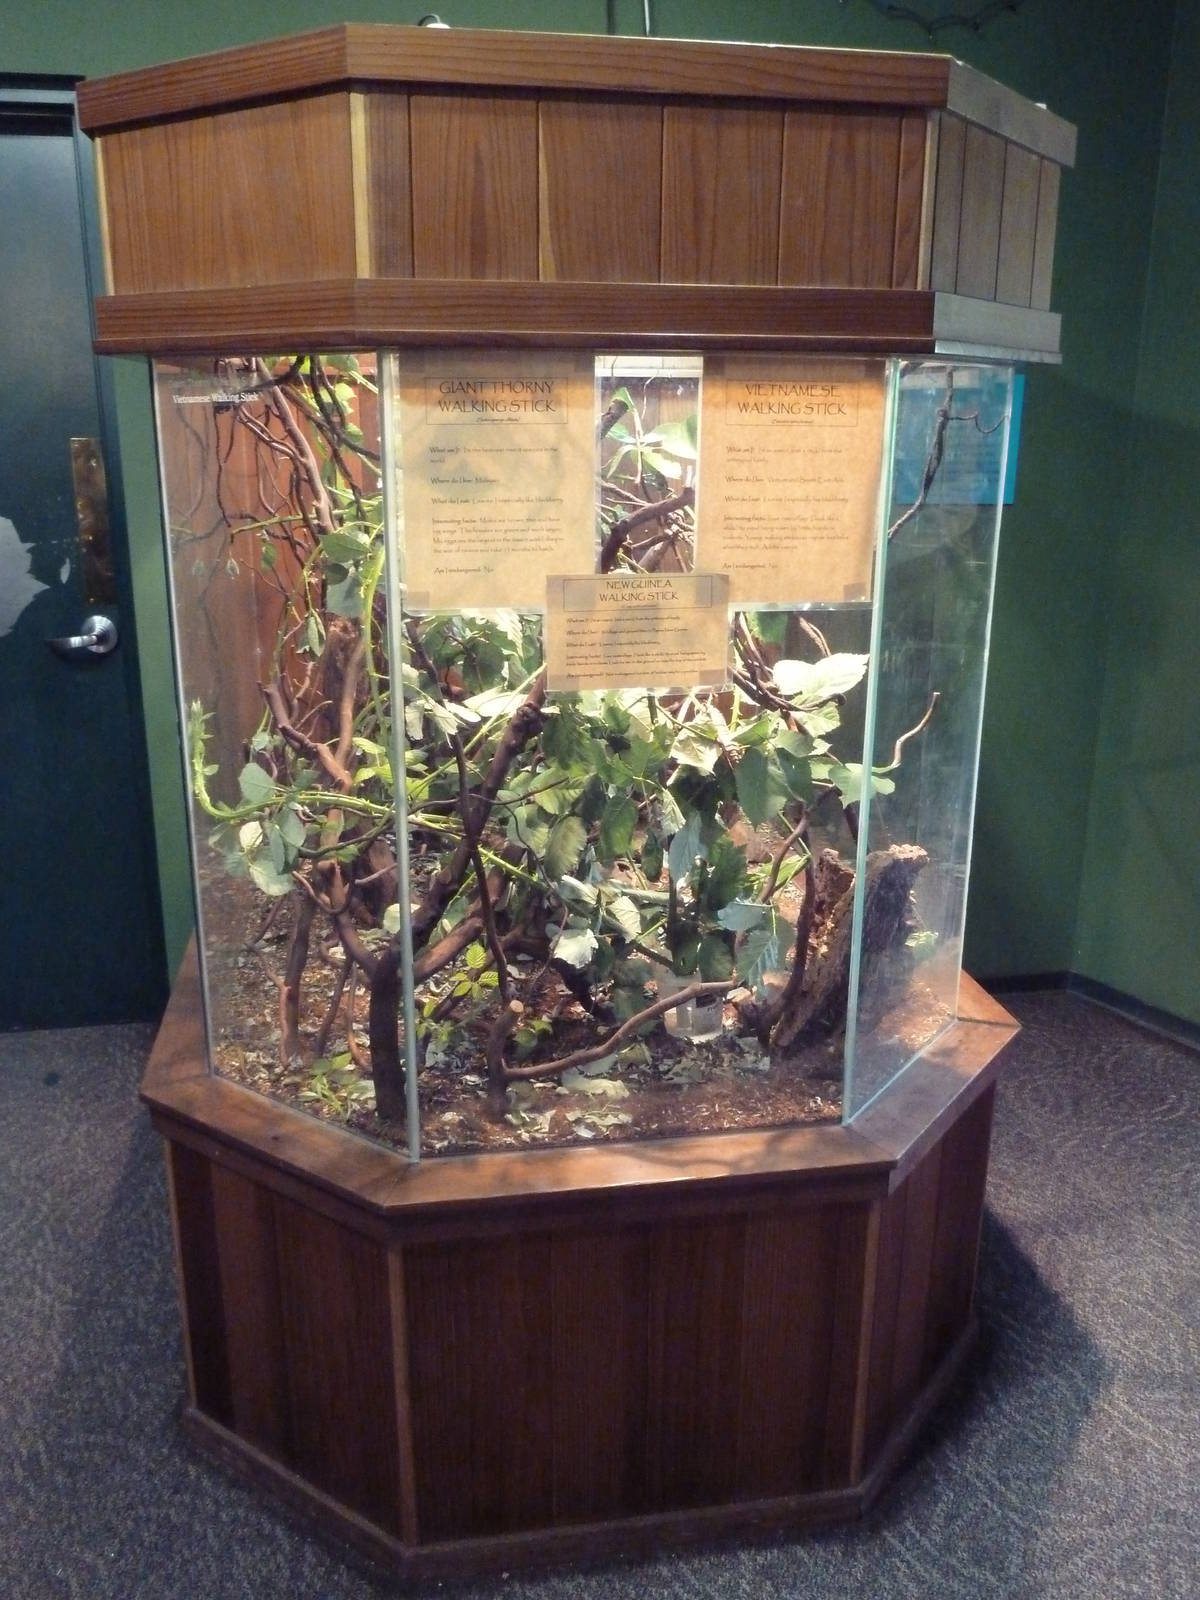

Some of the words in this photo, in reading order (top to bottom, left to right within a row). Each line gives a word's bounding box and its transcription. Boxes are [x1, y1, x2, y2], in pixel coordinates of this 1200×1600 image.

[439, 380, 488, 395] GIANT
[490, 380, 555, 395] THORNY
[745, 383, 841, 398] VIETNAMESE
[438, 399, 507, 413] WALKING
[509, 399, 557, 413] STICK
[737, 401, 801, 416] WALKING
[802, 401, 847, 415] STICK
[606, 580, 630, 590] NEW
[631, 579, 673, 590] GUINEA
[599, 592, 646, 602] WALKING
[646, 591, 680, 602] STICK
